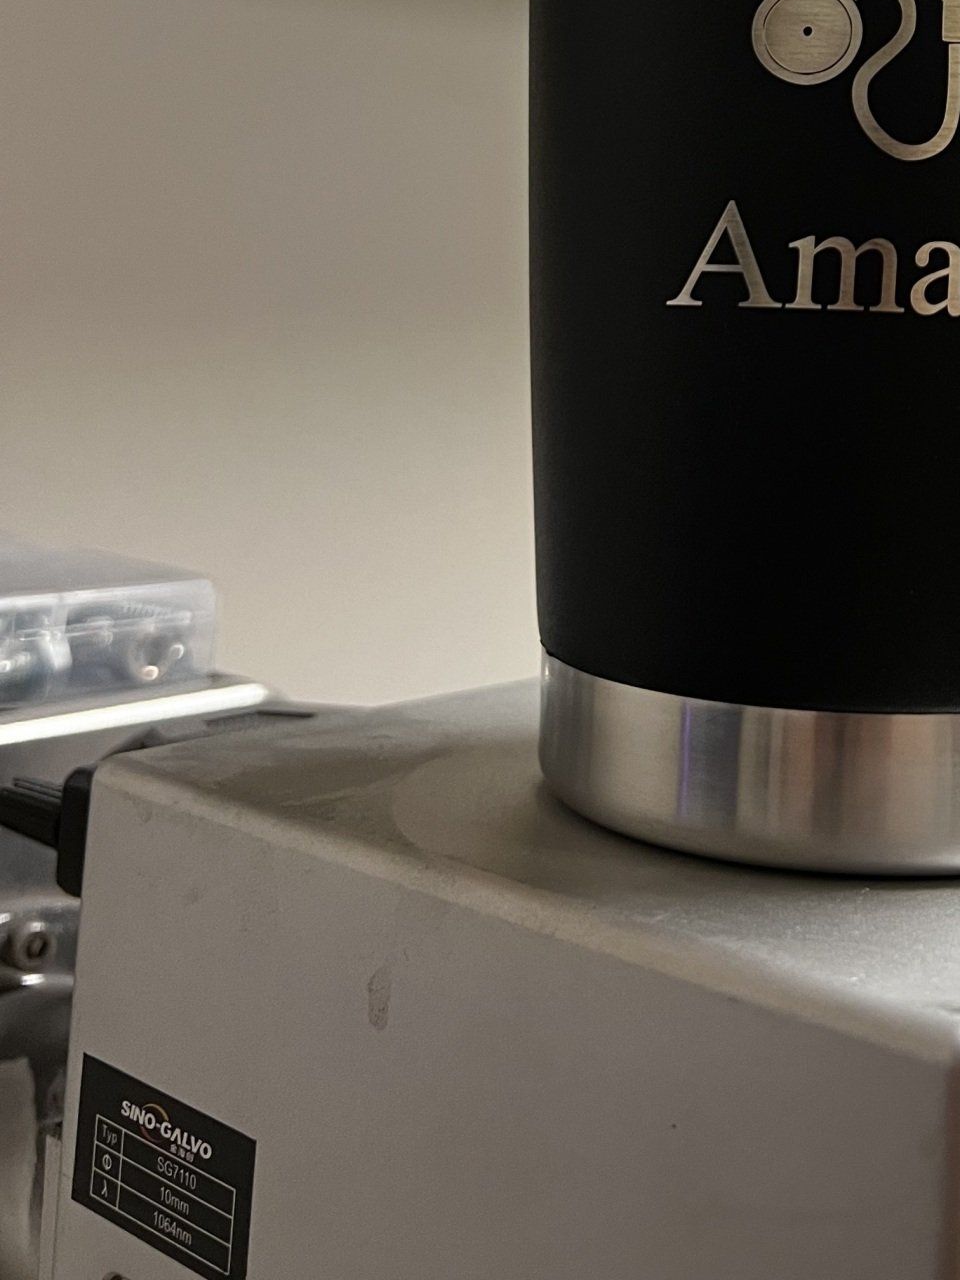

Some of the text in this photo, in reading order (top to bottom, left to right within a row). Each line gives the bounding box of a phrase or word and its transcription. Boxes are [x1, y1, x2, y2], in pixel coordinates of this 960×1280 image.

[101, 1124, 118, 1145] Typ
[120, 1100, 213, 1160] SINO-GALVO
[156, 1156, 197, 1190] SG7110
[159, 1186, 190, 1215] 10mm
[152, 1211, 193, 1246] 1064nm
